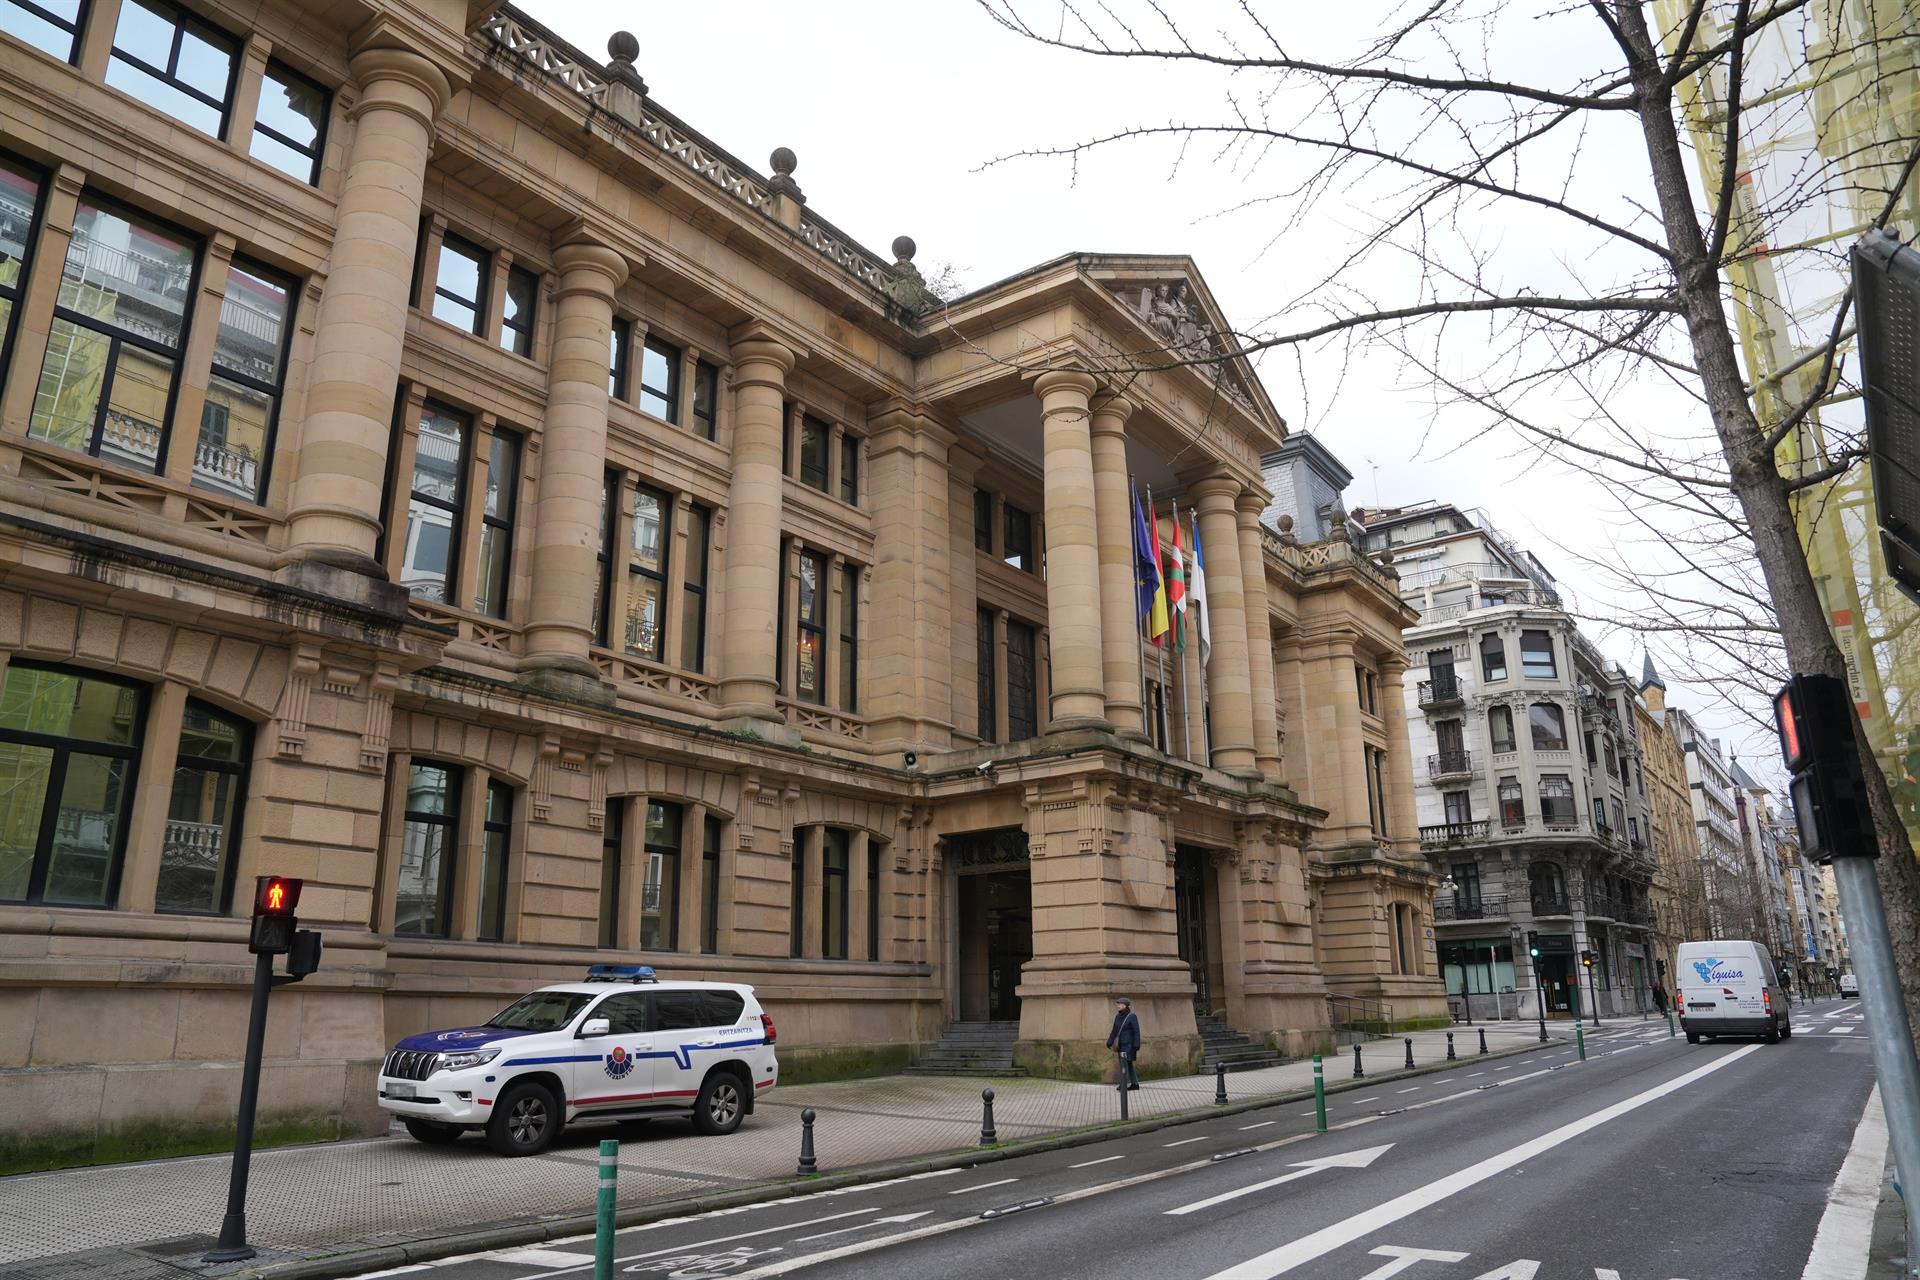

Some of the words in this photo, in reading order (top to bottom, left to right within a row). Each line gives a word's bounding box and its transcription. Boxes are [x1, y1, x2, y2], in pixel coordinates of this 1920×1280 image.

[1168, 386, 1184, 412] DE
[718, 1027, 753, 1037] ERTZAINTZA
[604, 1065, 635, 1080] ERTZAINTZA
